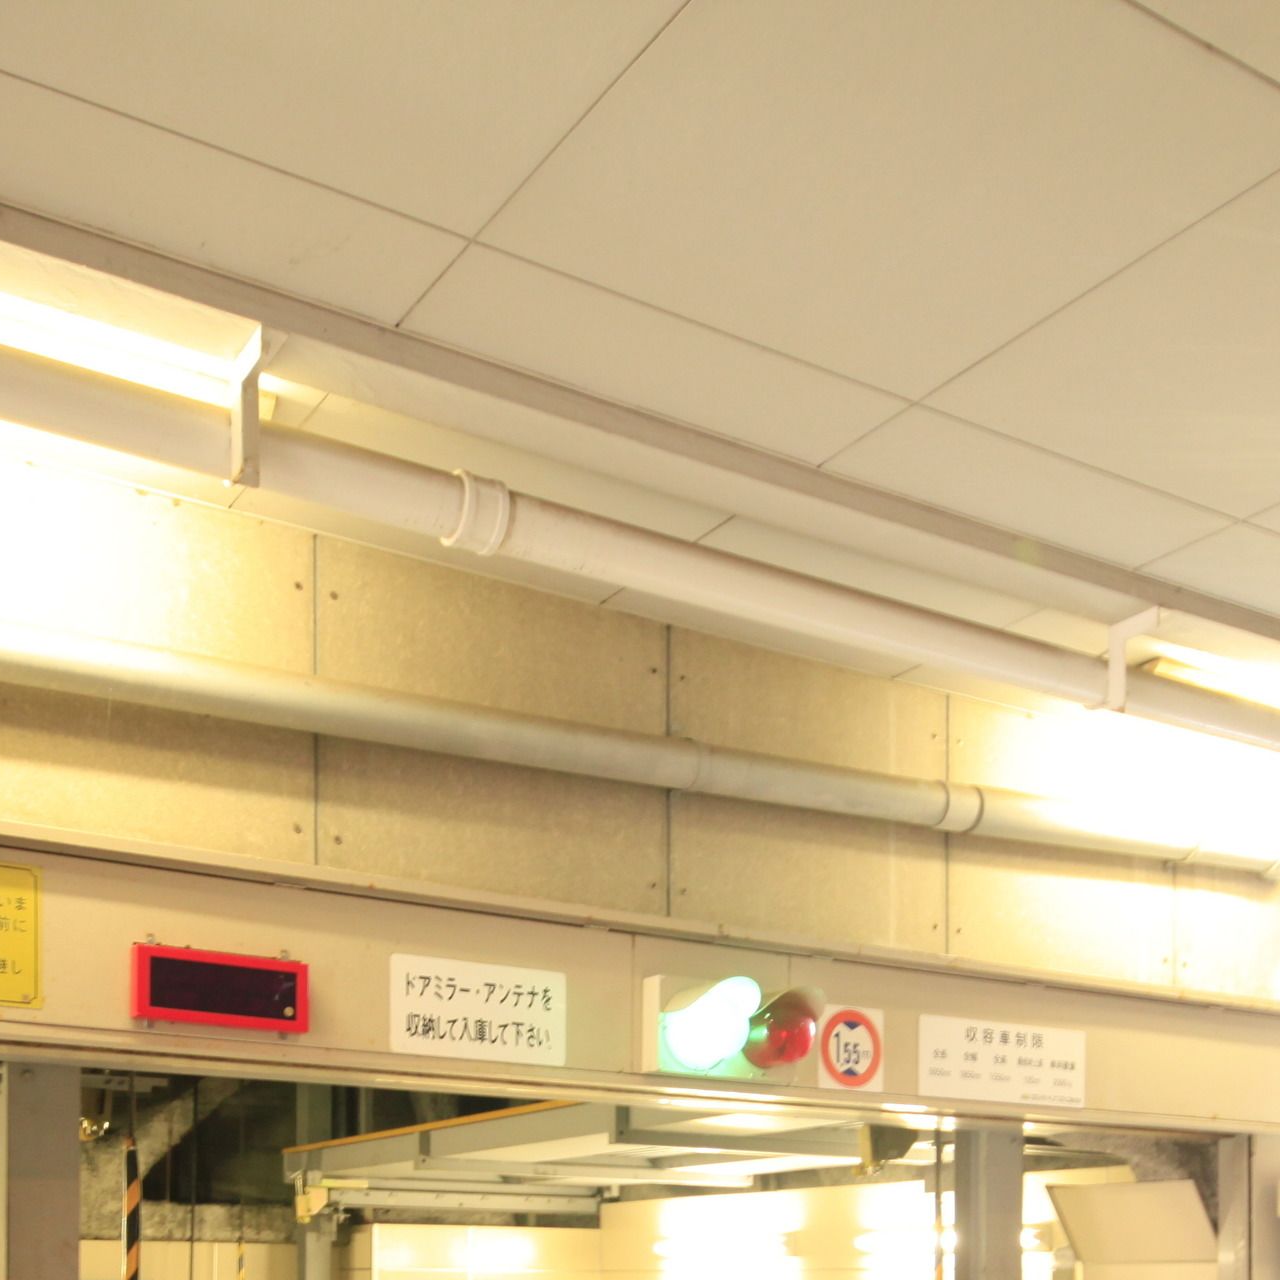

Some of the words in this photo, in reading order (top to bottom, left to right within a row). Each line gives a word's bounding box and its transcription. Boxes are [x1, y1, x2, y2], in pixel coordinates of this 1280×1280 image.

[405, 972, 553, 1011] ドアミラー・アンテナを
